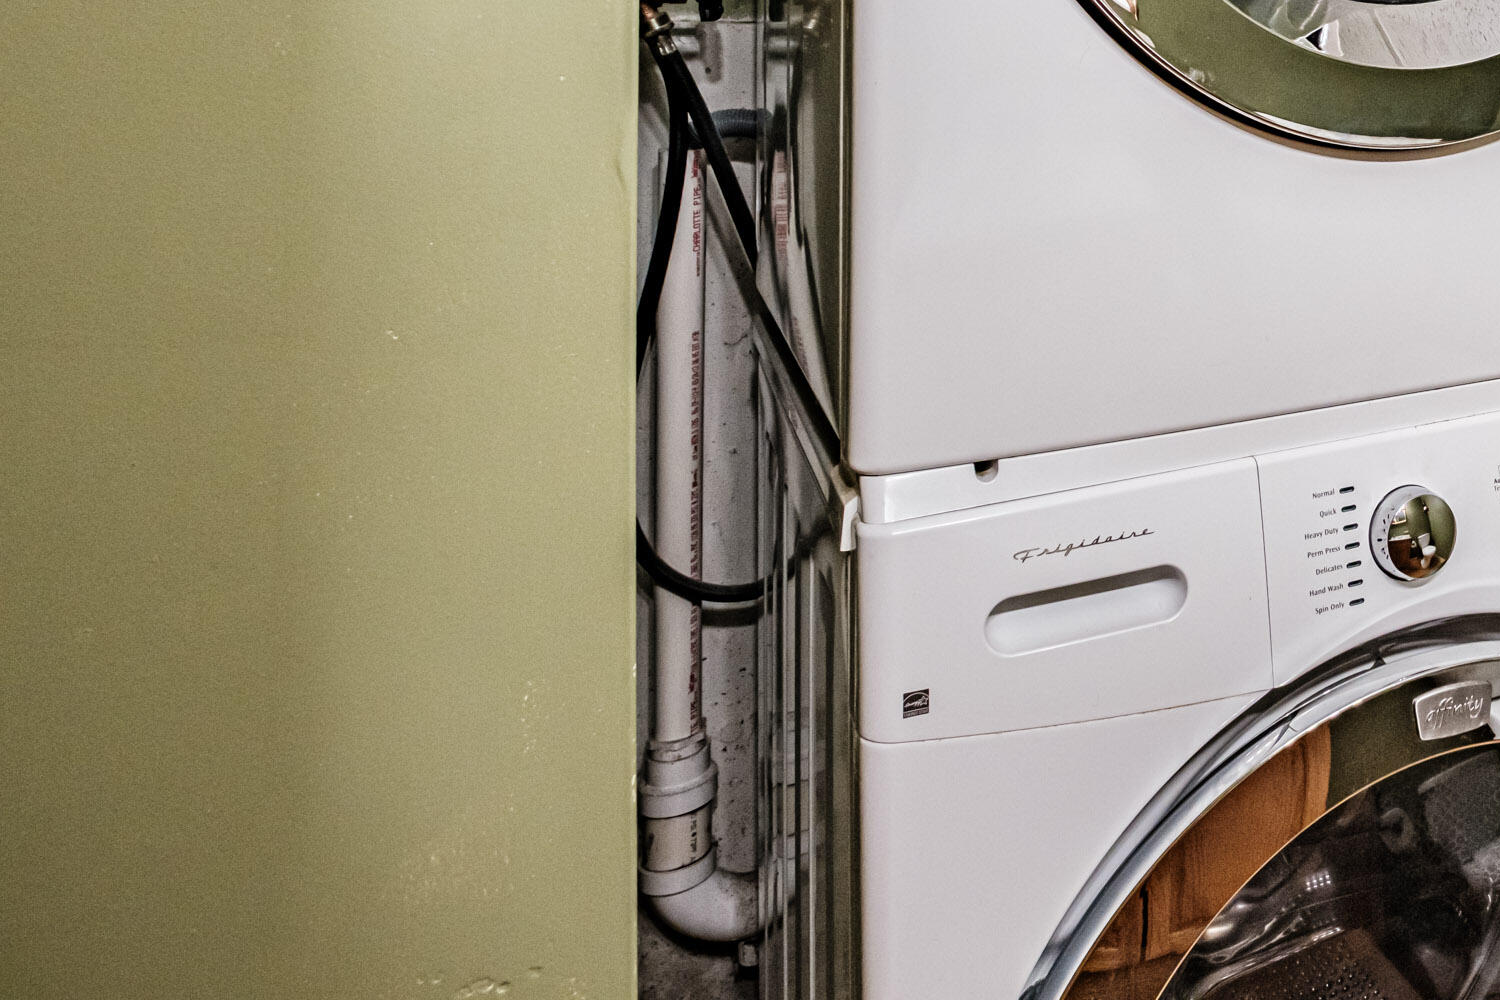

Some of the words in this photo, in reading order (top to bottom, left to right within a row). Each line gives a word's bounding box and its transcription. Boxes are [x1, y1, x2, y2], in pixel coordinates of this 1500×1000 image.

[693, 186, 702, 206] PIPE
[692, 210, 701, 253] CHARLOTTE
[1312, 488, 1335, 499] Normal
[1319, 508, 1336, 518] Quick
[1304, 531, 1323, 540] Heavy
[1324, 528, 1339, 536] Duty
[1013, 528, 1155, 564] Frigidaire
[1307, 550, 1323, 559] Perm
[1325, 546, 1341, 555] Press
[1316, 564, 1343, 576] Delicates
[1309, 586, 1326, 597] Hand
[1328, 583, 1344, 592] Wash
[1315, 605, 1329, 616] Spin
[1330, 601, 1345, 611] Only
[1425, 694, 1484, 730] affinity
